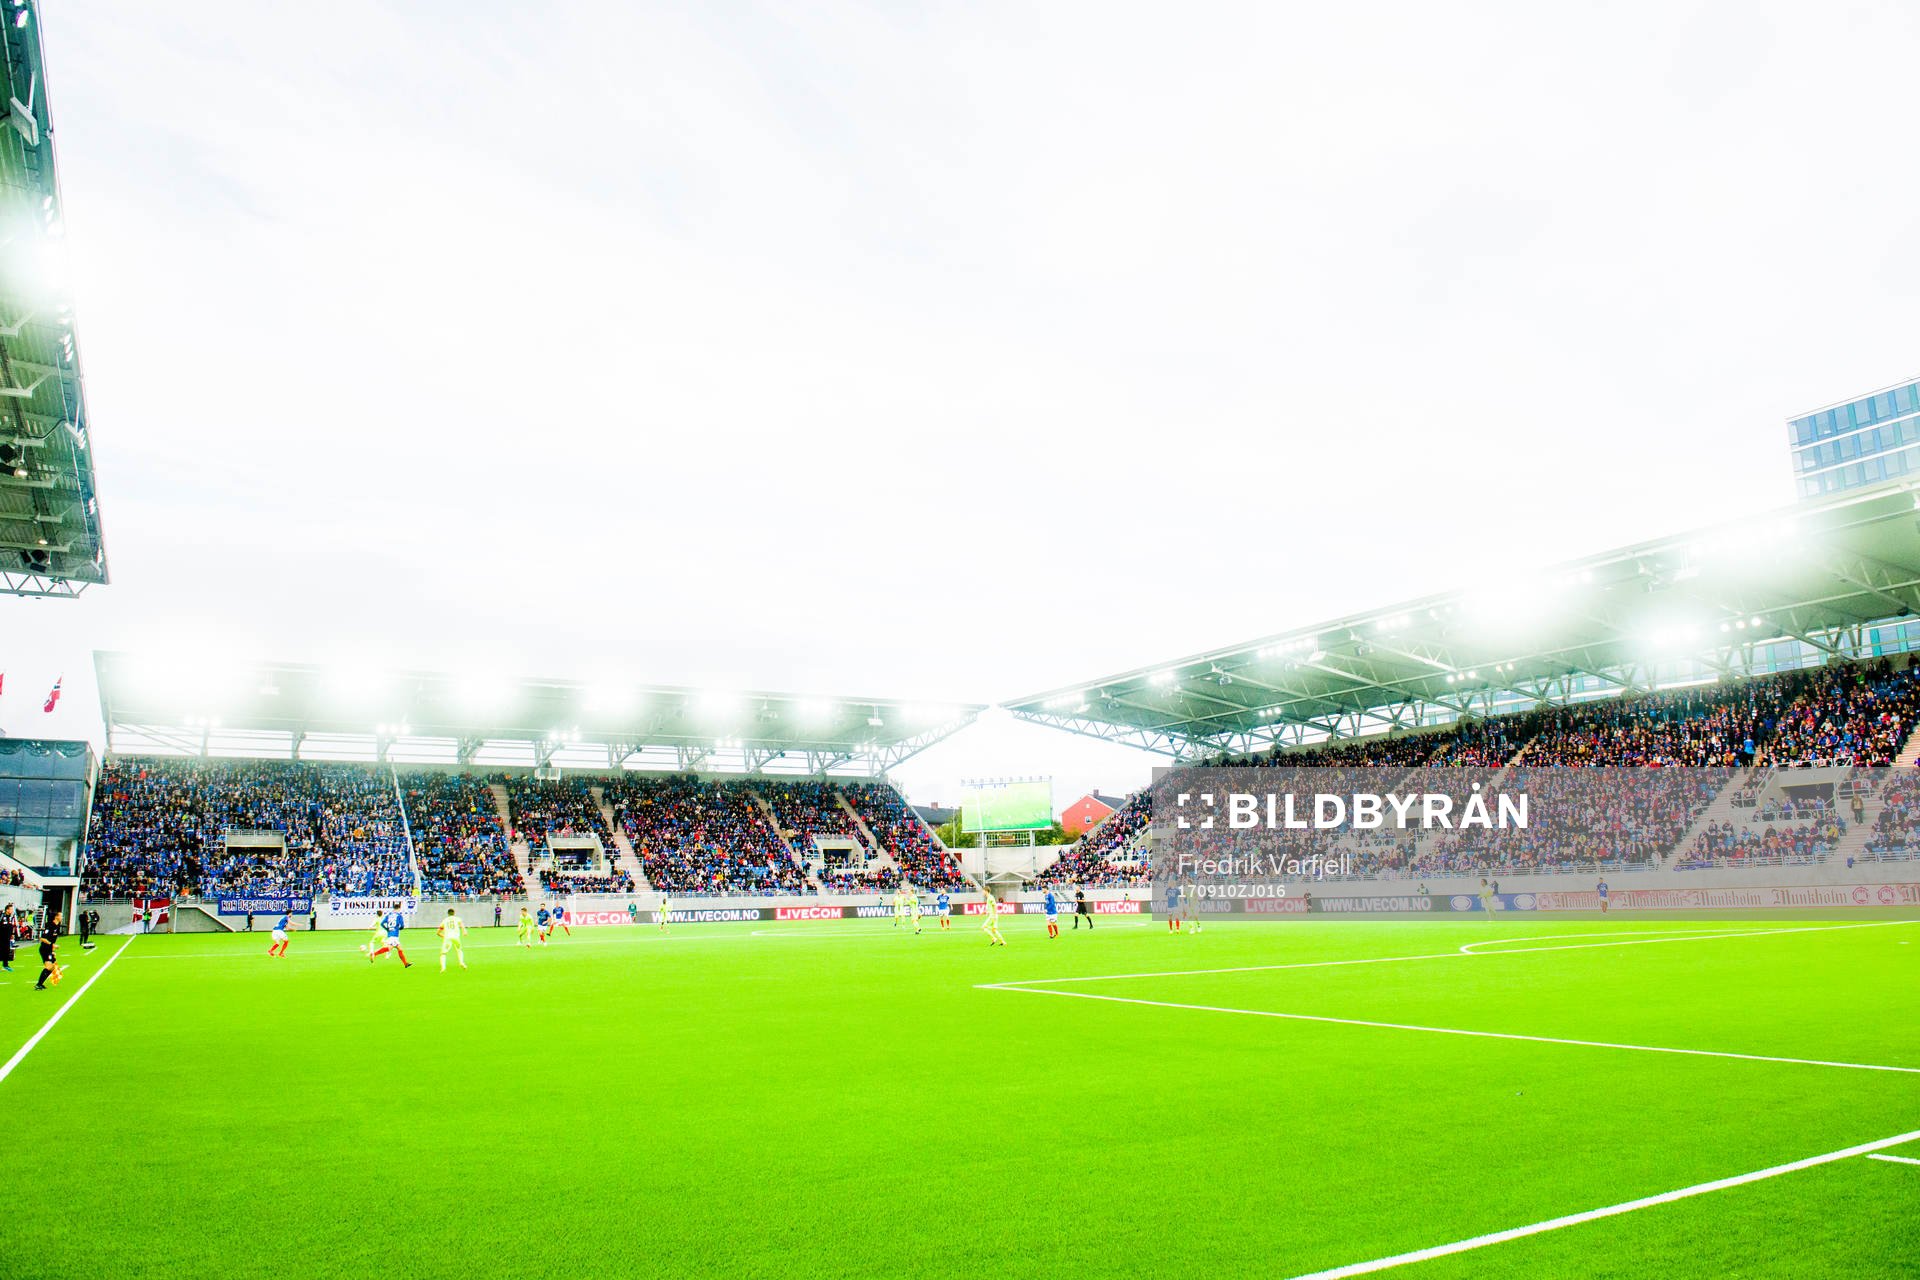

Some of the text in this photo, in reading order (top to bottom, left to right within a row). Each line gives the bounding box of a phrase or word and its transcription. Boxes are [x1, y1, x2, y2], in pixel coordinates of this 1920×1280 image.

[1771, 888, 1848, 905] Munkholm
[344, 901, 401, 909] FOSSEFALL
[1321, 897, 1431, 912] WWW.LIVECOM.NO
